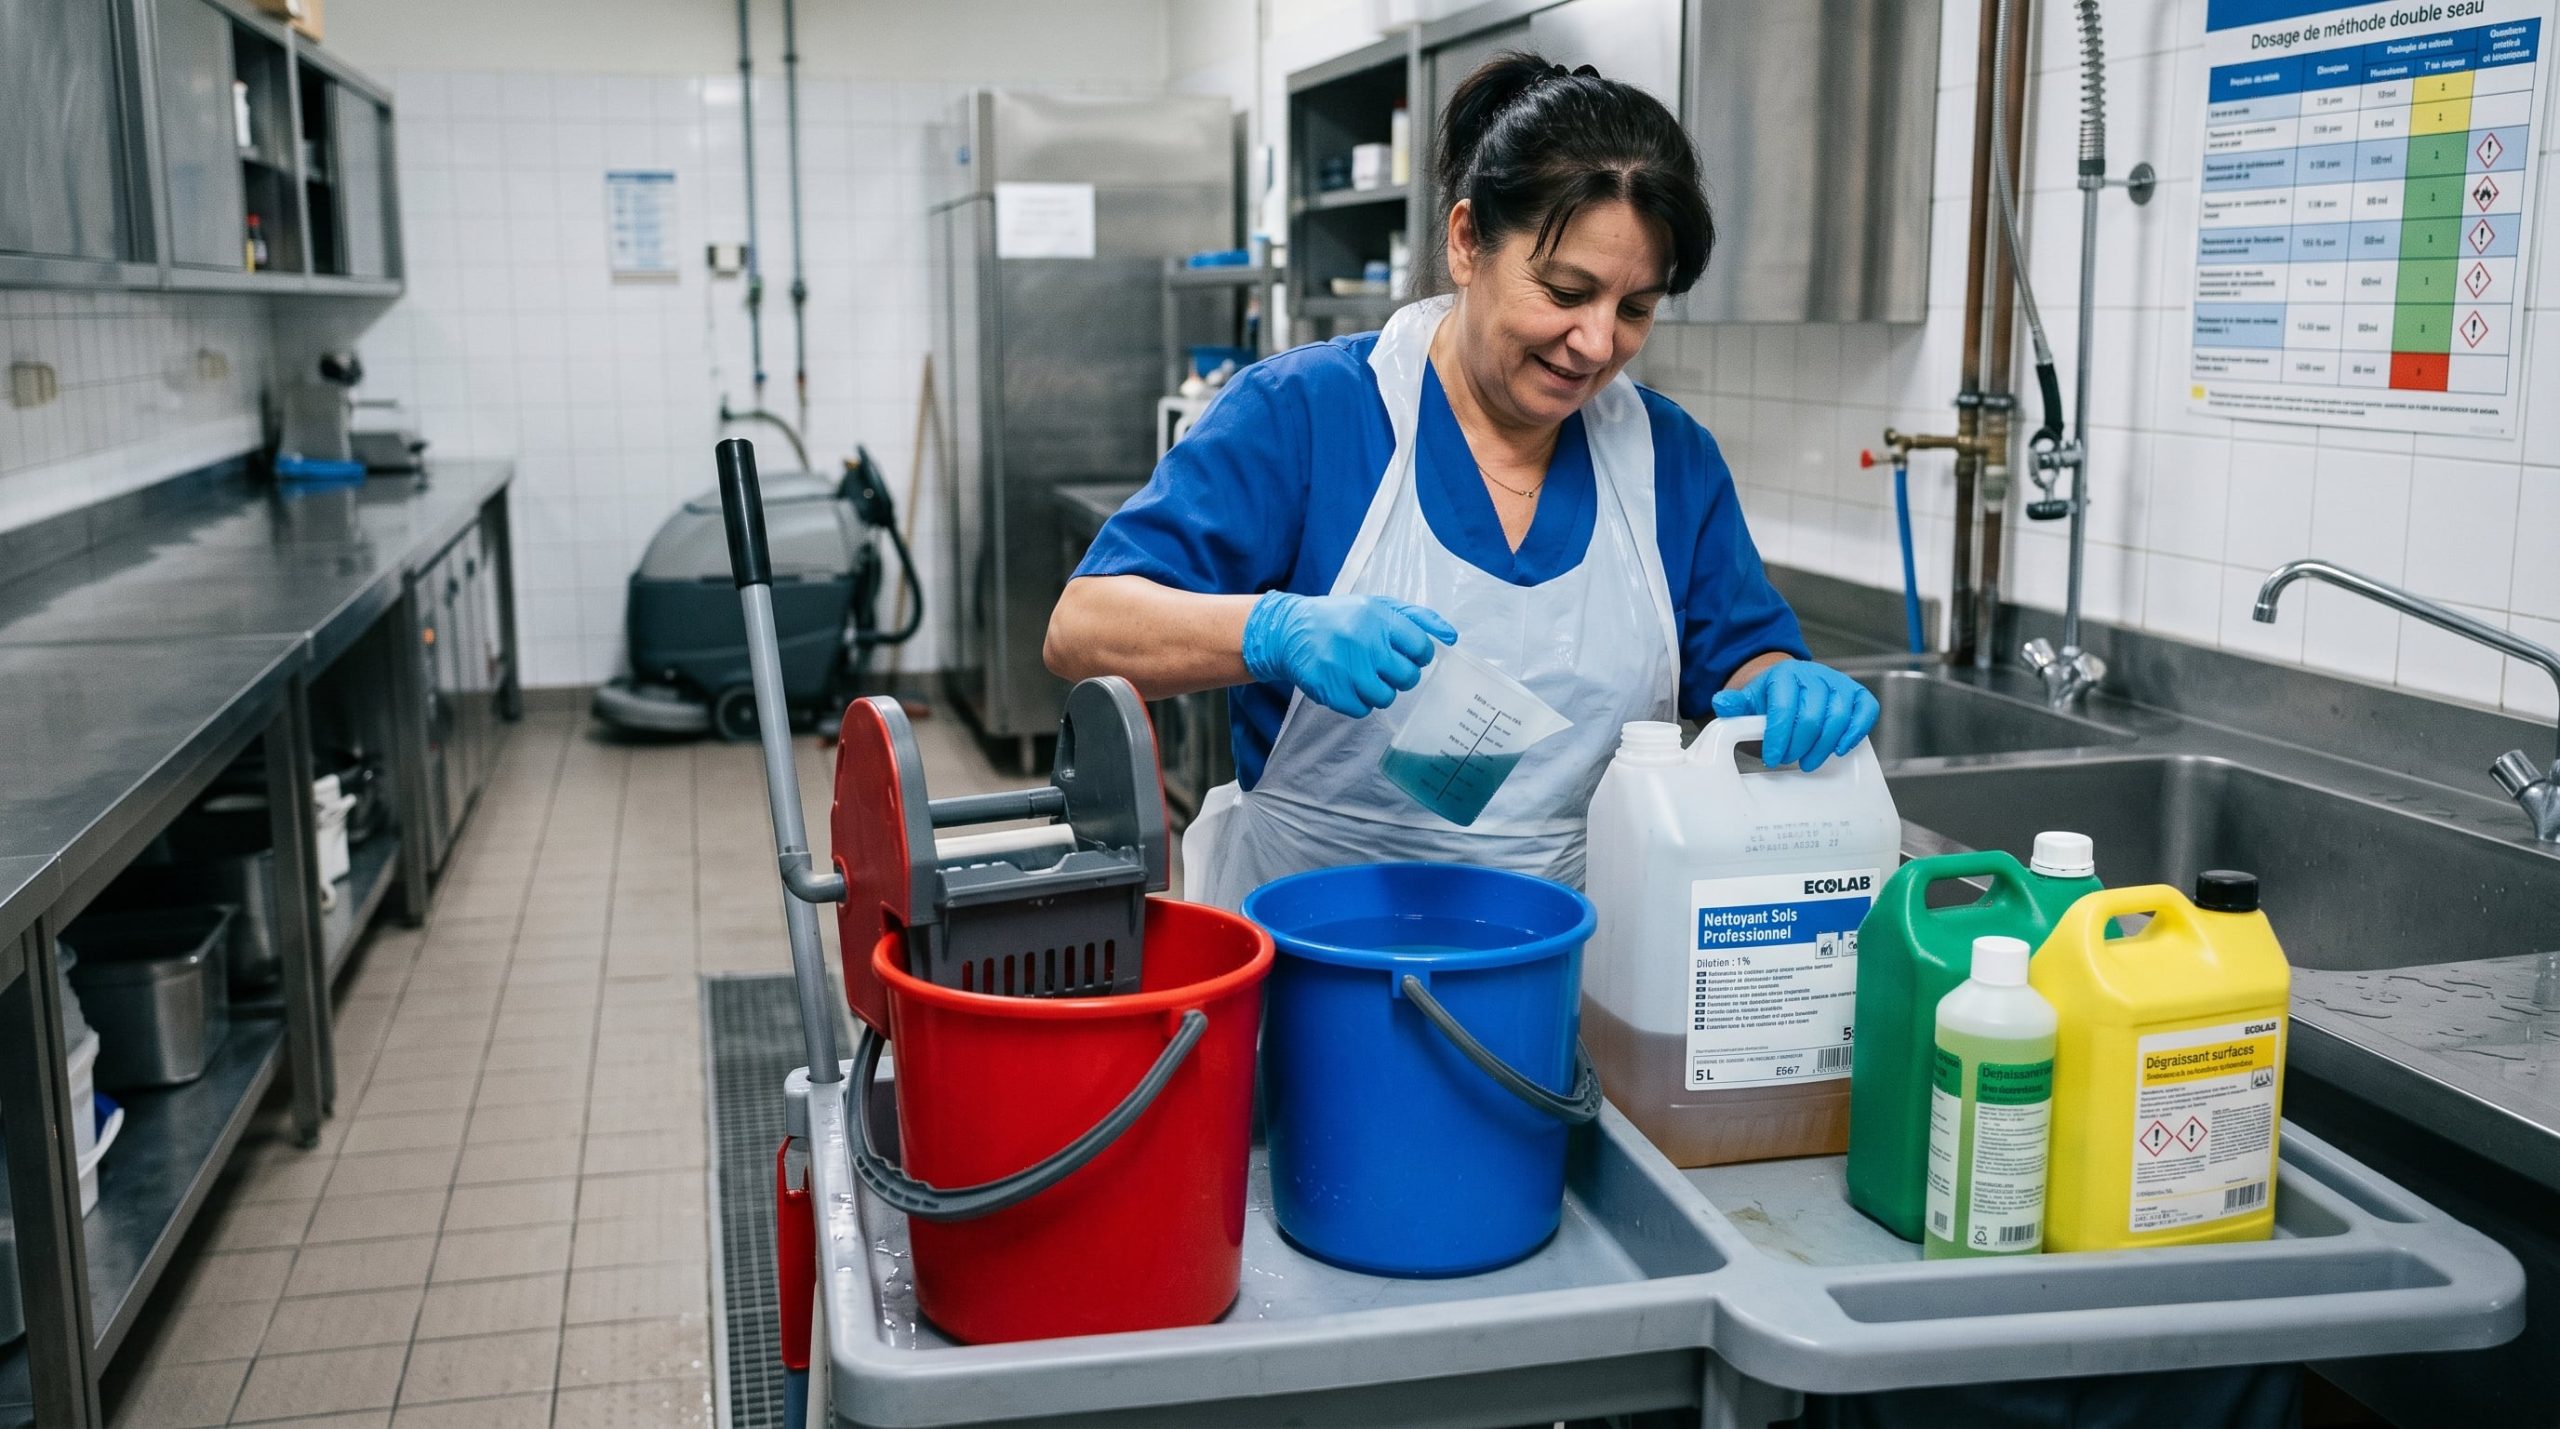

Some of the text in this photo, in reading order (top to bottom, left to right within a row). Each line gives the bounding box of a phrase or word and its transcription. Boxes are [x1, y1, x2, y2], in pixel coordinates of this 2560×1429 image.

[2251, 0, 2484, 50] Dosage de méthode double seau
[1804, 876, 1871, 894] ECOLAB
[1704, 908, 1798, 928] Nettoyant Sols
[1704, 925, 1792, 944] Professionnel
[1737, 956, 1751, 966] 1%
[2146, 1050, 2209, 1070] Dégraissant
[1696, 1068, 1714, 1081] 5 L
